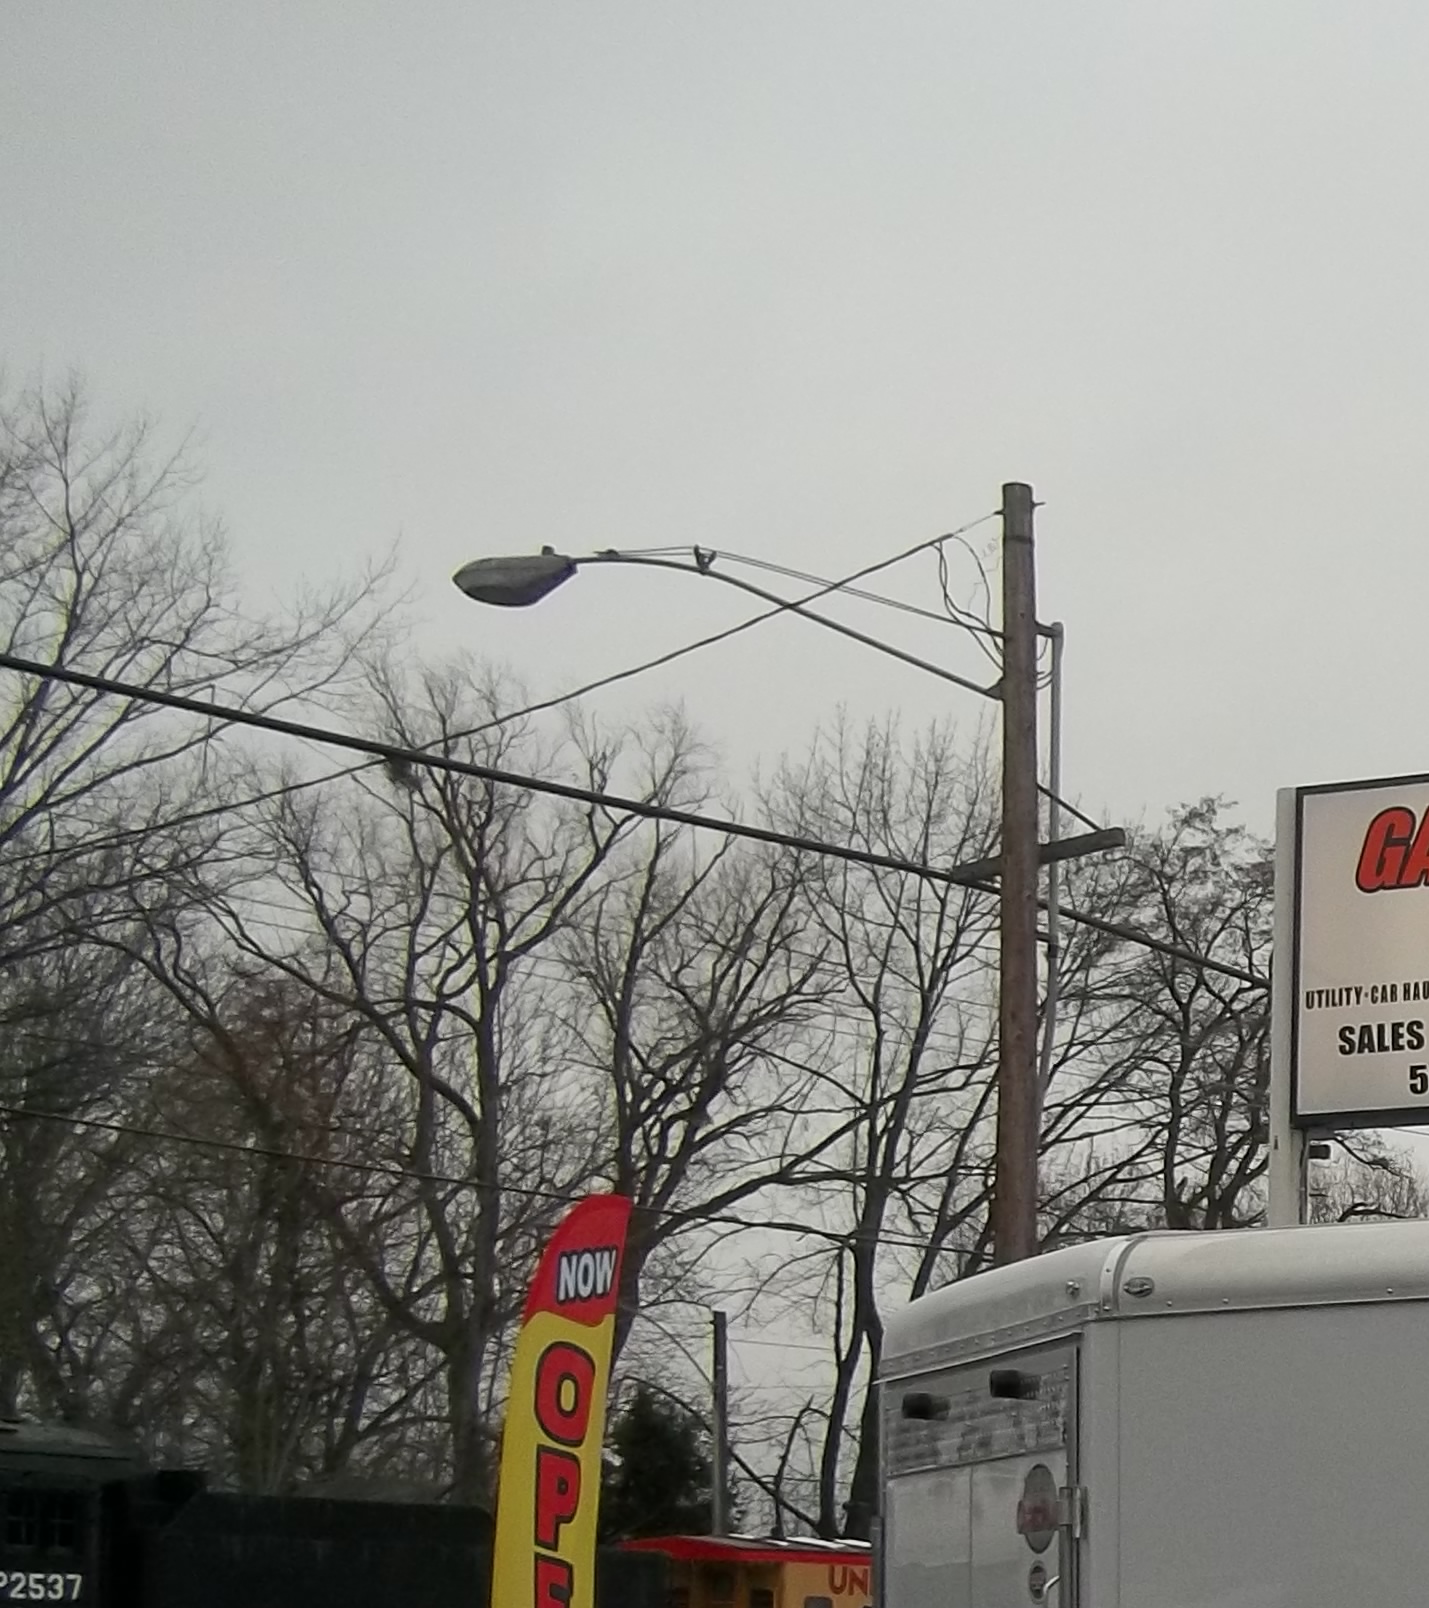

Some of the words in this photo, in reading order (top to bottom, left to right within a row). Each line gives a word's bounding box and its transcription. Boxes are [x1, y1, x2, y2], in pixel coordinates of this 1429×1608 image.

[1305, 986, 1364, 1010] UTILITY
[1370, 983, 1398, 1005] CAR
[1338, 1020, 1425, 1055] SALES
[558, 1247, 617, 1303] NOW
